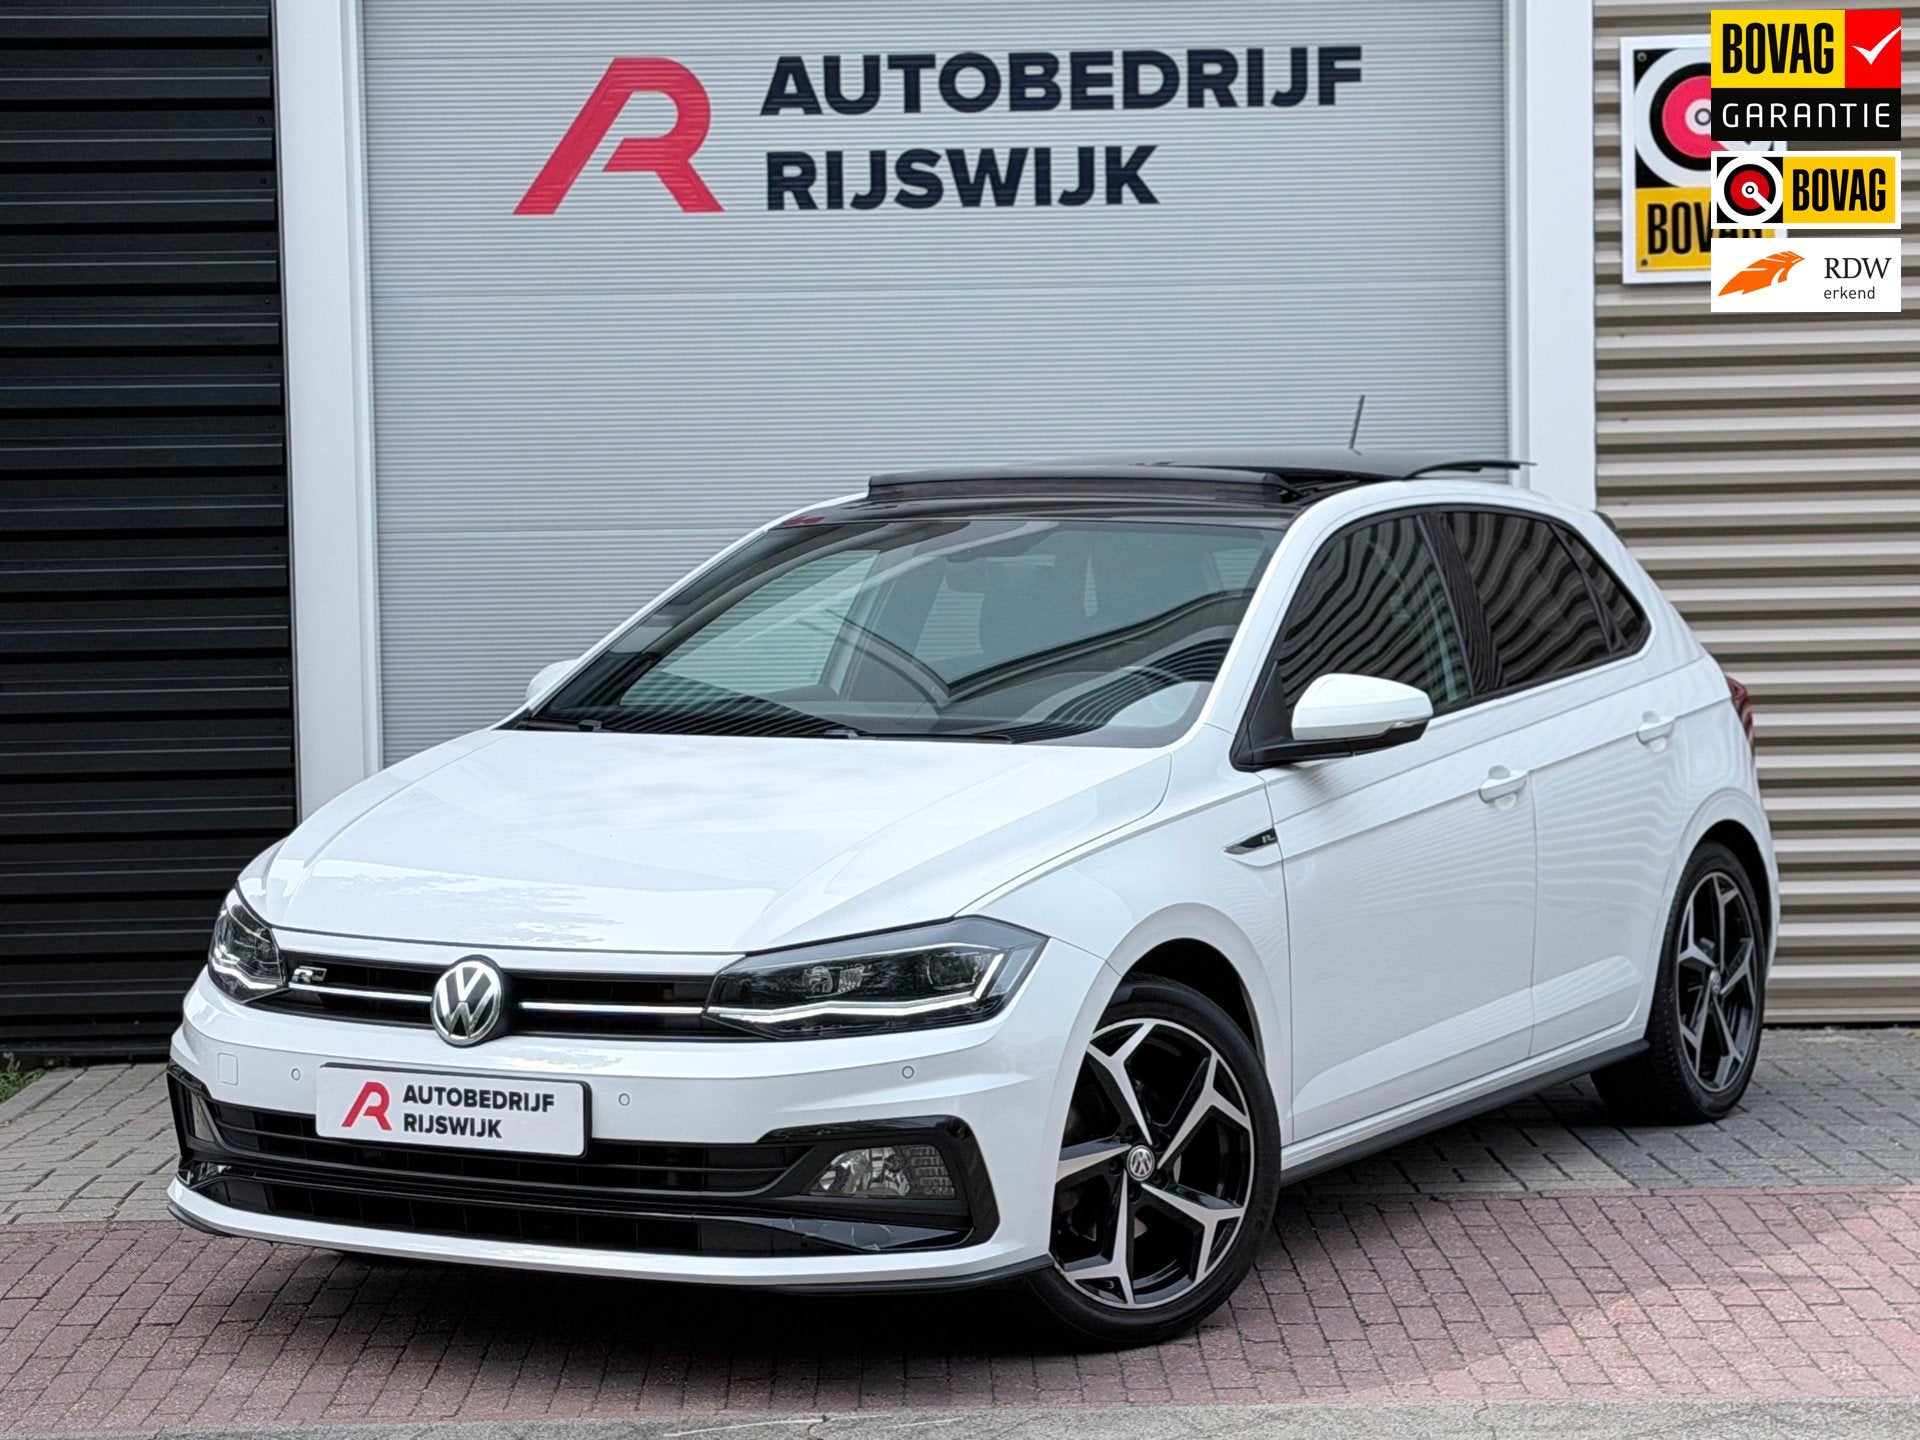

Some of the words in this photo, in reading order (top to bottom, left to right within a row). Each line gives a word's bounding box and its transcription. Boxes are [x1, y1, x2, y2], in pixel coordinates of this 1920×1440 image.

[760, 46, 1362, 116] AUTOBEDRIJF
[766, 145, 1159, 211] RIJSWIJK
[402, 1084, 555, 1113] AUTOBEDRIJF
[403, 1112, 503, 1139] RIJSWIJK
